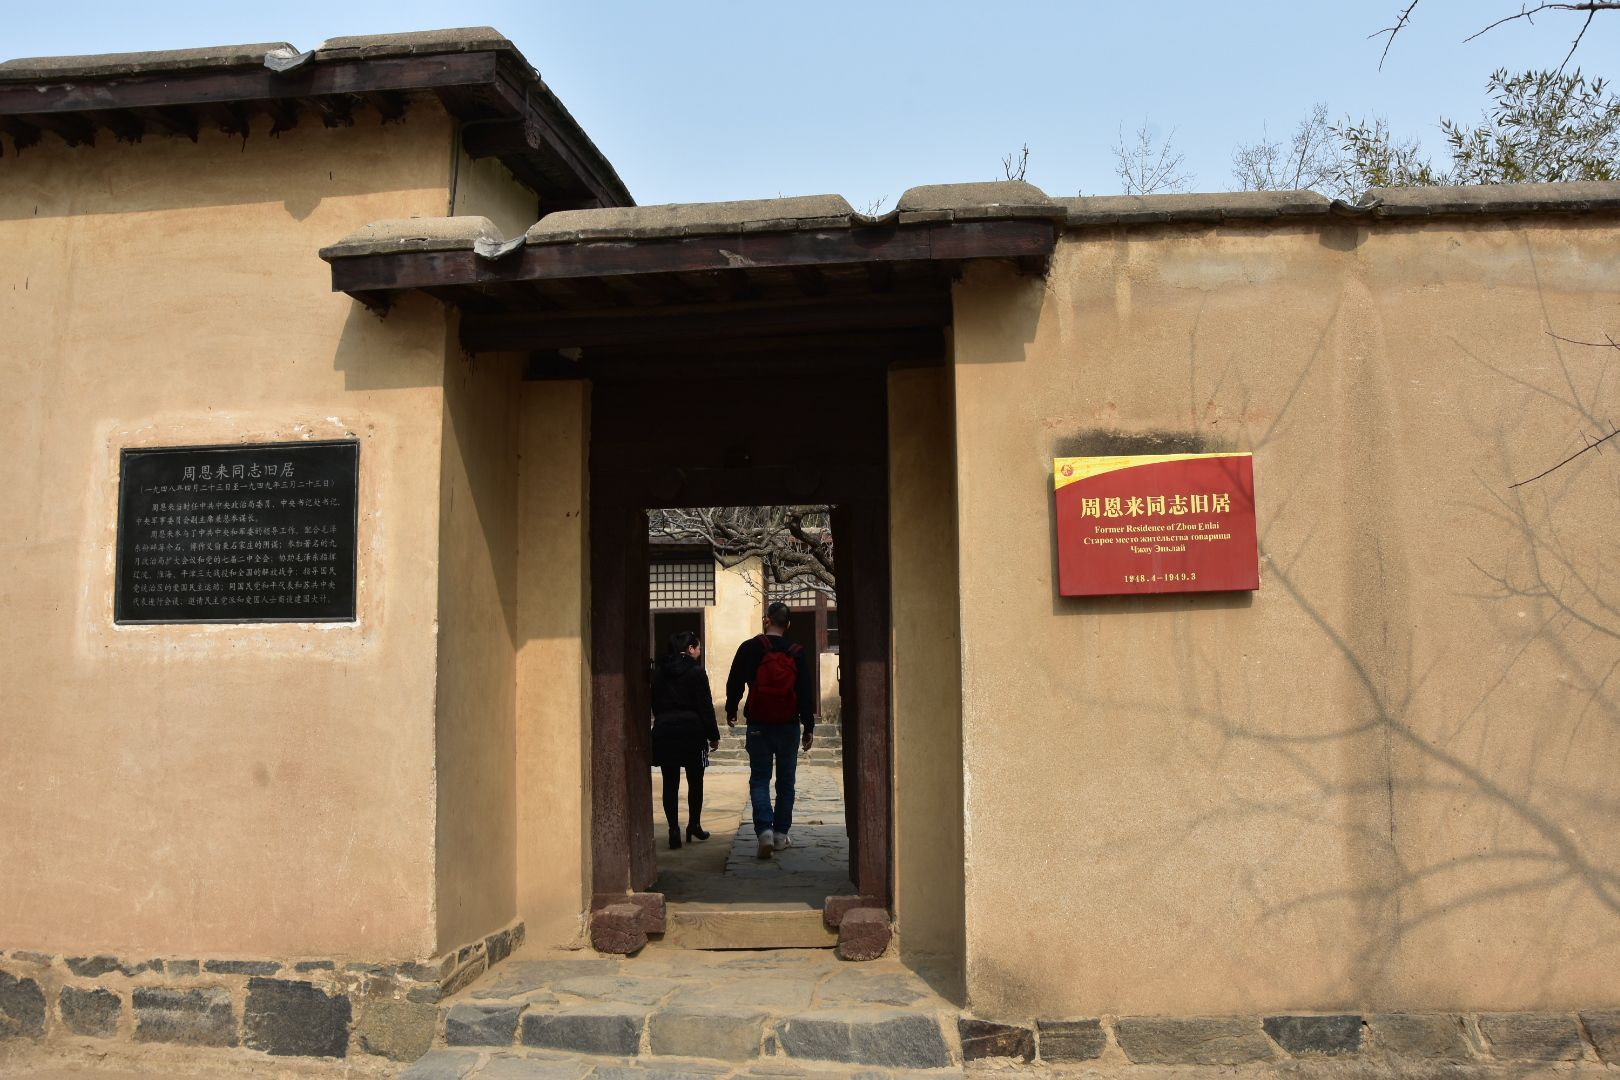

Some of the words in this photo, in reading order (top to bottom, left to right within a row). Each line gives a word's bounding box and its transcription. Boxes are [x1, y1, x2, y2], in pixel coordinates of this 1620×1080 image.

[182, 462, 294, 480] 周恩来同志旧居
[1081, 493, 1230, 518] 周恩来同志旧居
[1095, 525, 1124, 533] Former
[1176, 523, 1196, 531] Zhou
[1198, 522, 1219, 530] Enlai
[1084, 537, 1113, 546] Старое
[1140, 534, 1188, 543] жительства
[1190, 532, 1231, 541] товарища
[1131, 546, 1152, 554] Чжоу
[1155, 544, 1185, 553] Эньлай
